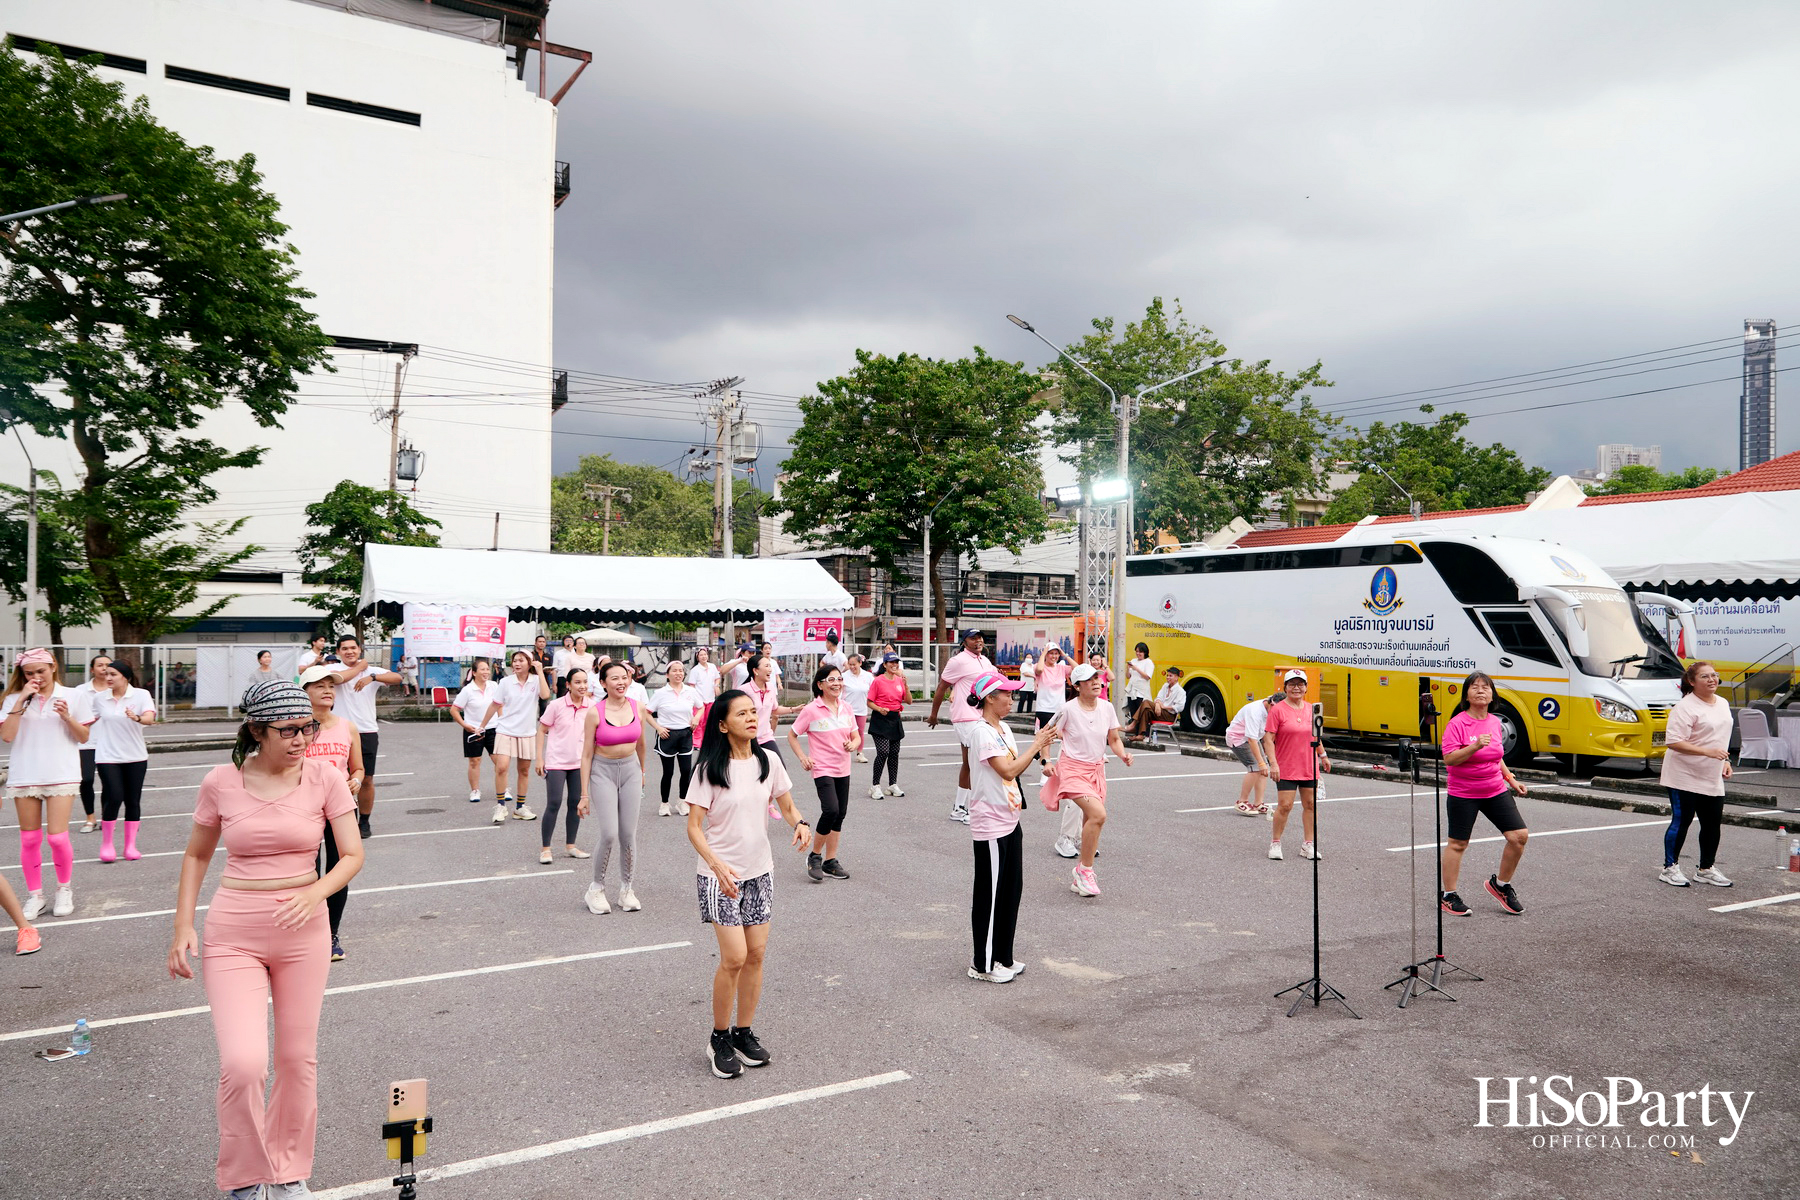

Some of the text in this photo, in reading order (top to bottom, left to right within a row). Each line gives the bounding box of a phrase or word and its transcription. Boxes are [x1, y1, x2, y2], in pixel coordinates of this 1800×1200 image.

[1334, 614, 1434, 635] มูลนิธิกาญจนบารมี
[1320, 637, 1450, 651] รถสาธิตและตรวจมะเร็งเต้านมเคลื่อนที่
[1713, 639, 1722, 647] 70
[1543, 700, 1555, 717] 2
